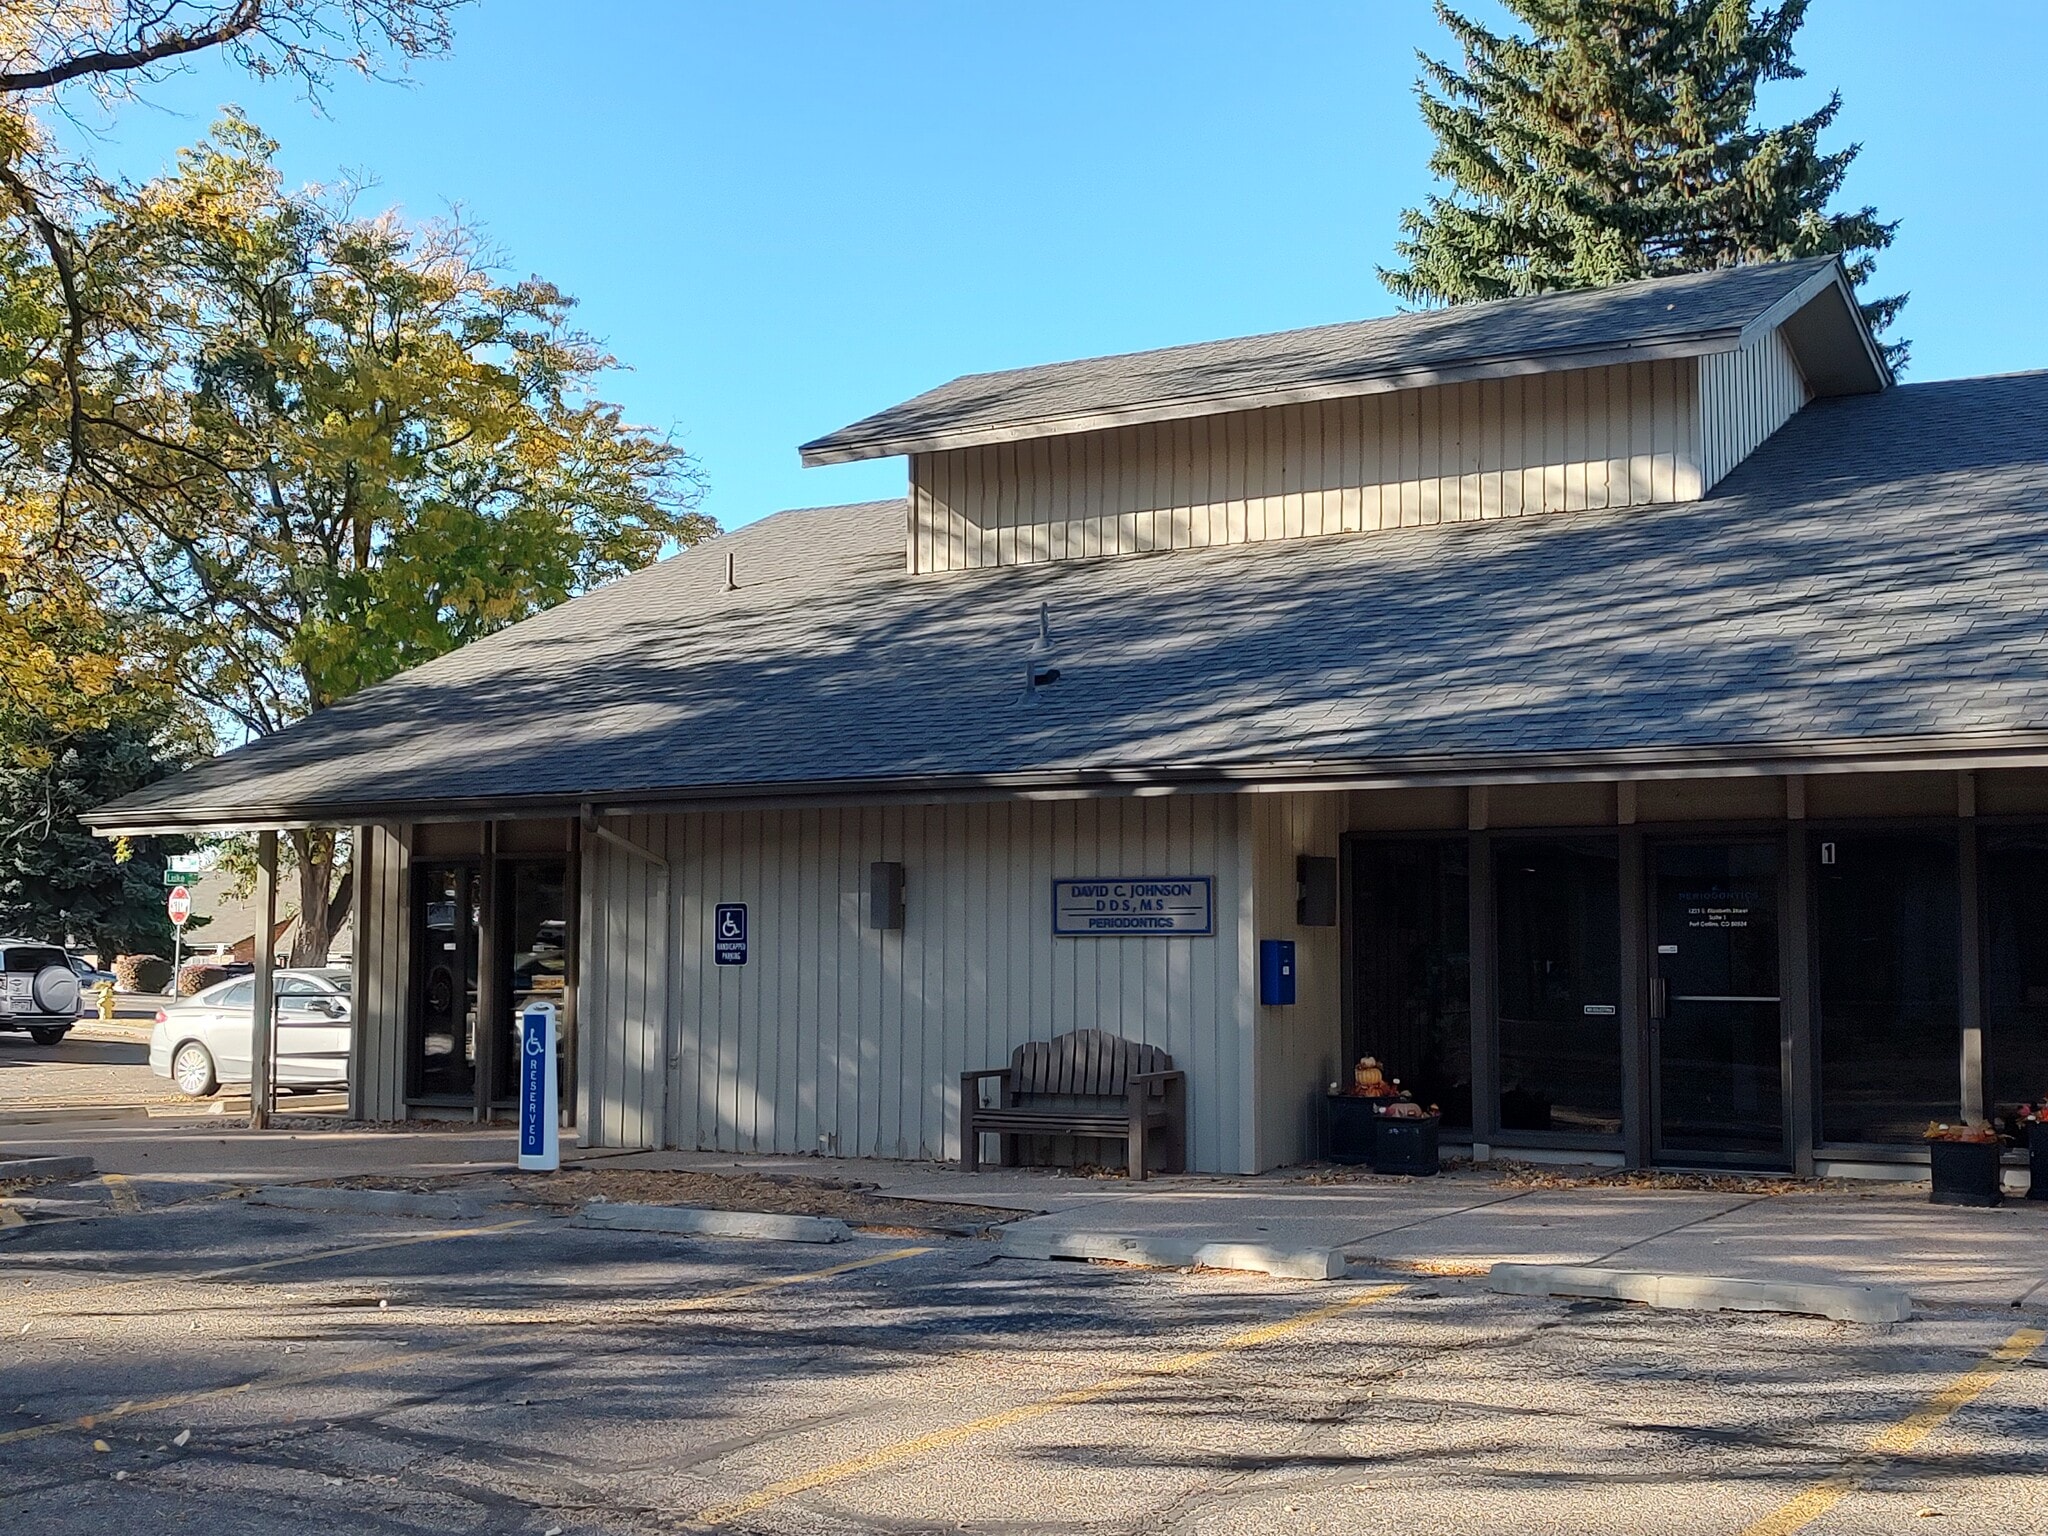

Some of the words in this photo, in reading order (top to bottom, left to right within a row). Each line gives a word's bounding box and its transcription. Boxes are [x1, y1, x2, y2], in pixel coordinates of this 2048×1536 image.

[1071, 886, 1109, 897] DAVID
[1130, 884, 1192, 898] JOHNSON
[1089, 917, 1174, 929] PERIODONTICS
[722, 952, 741, 960] PARKING
[528, 1059, 538, 1145] RESERVED
